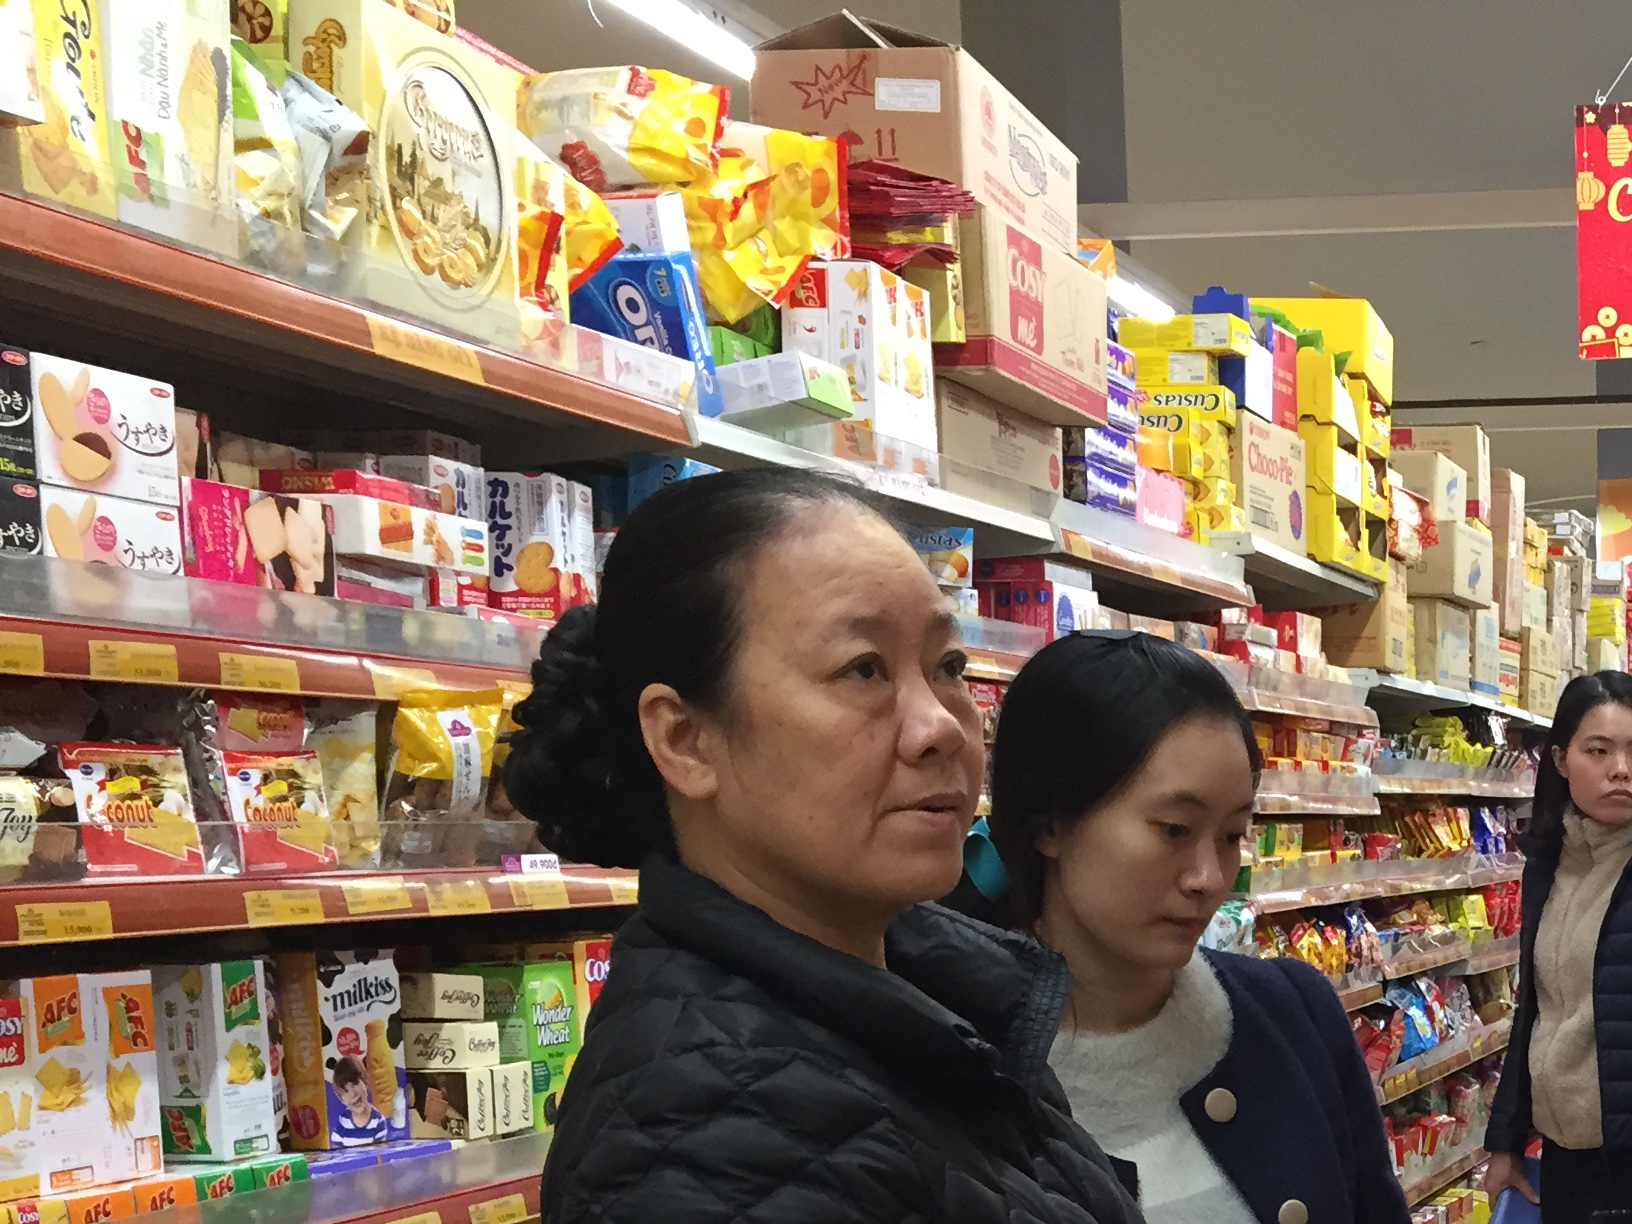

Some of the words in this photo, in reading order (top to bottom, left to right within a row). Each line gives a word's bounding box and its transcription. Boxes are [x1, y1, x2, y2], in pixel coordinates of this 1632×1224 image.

[1007, 247, 1045, 302] COSY
[914, 533, 963, 550] ustas
[84, 794, 155, 827] Cconut
[584, 958, 611, 983] COS
[227, 976, 255, 1008] AFC
[330, 975, 398, 1012] milkiss
[42, 991, 79, 1027] AFC
[532, 1004, 573, 1025] Wonder
[536, 1025, 571, 1047] Wheat
